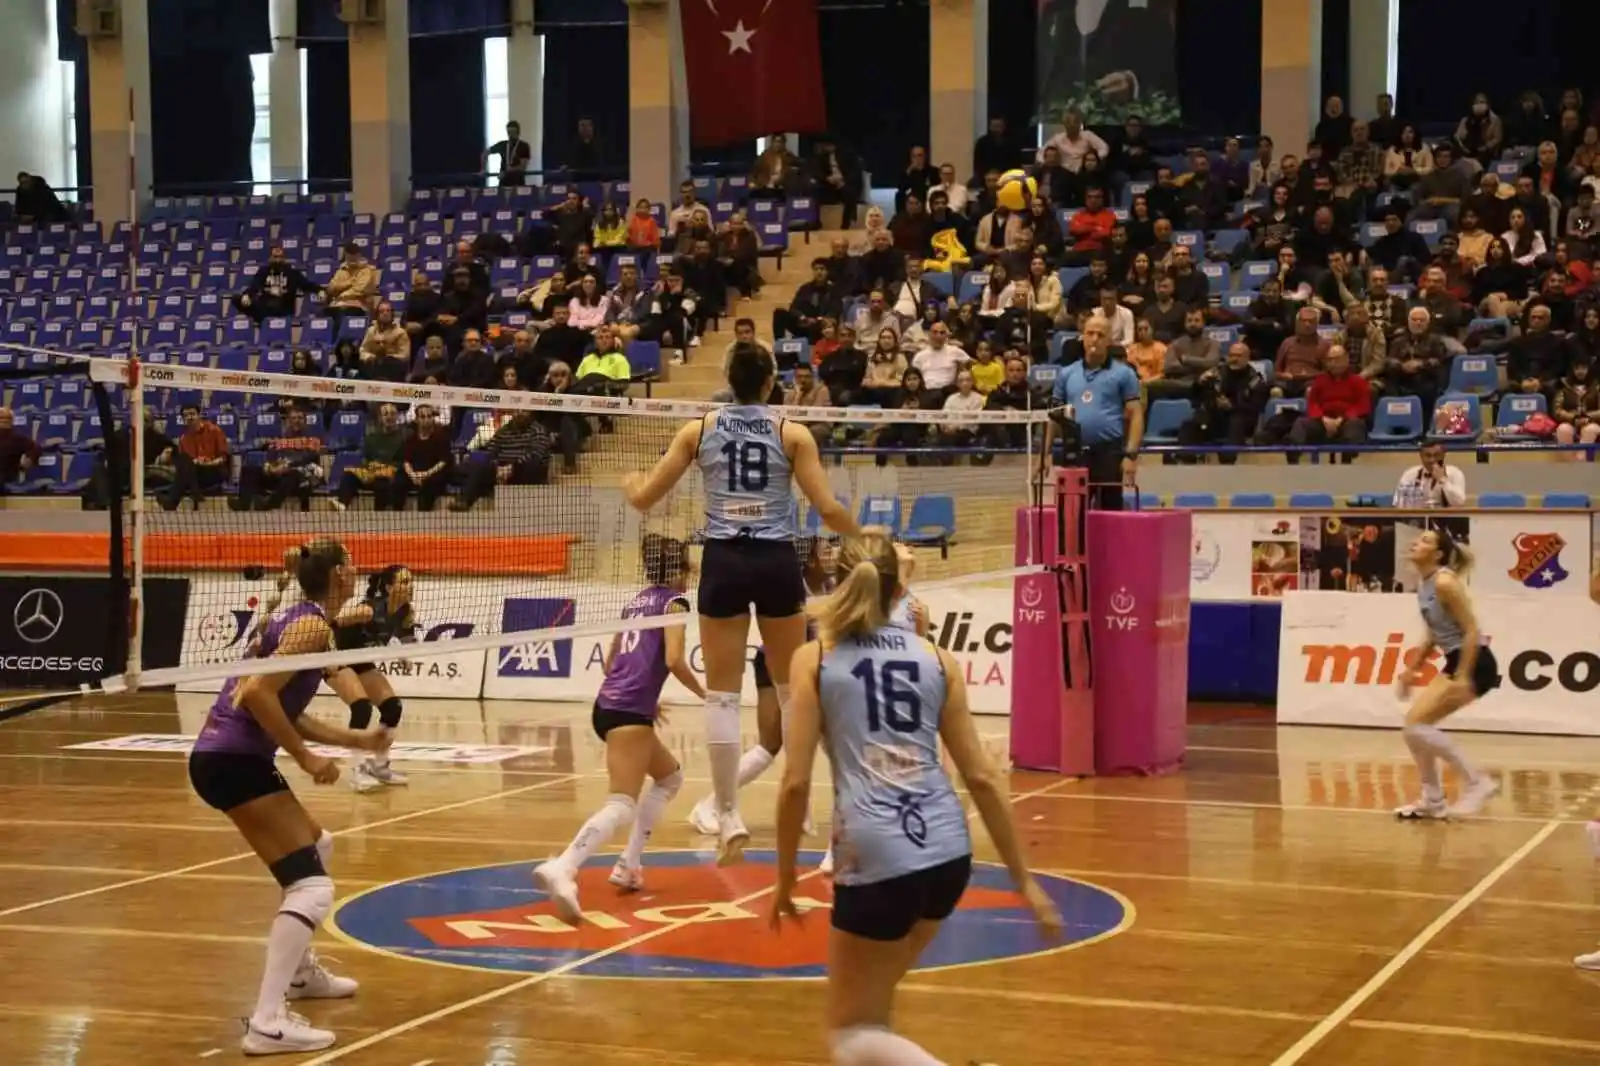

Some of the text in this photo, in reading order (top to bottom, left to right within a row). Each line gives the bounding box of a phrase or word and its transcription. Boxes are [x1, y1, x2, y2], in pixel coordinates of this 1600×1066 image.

[721, 440, 769, 492] 18
[1018, 608, 1046, 624] TVF
[1105, 616, 1139, 631] TVF
[498, 641, 559, 672] AXA
[851, 658, 921, 733] 16
